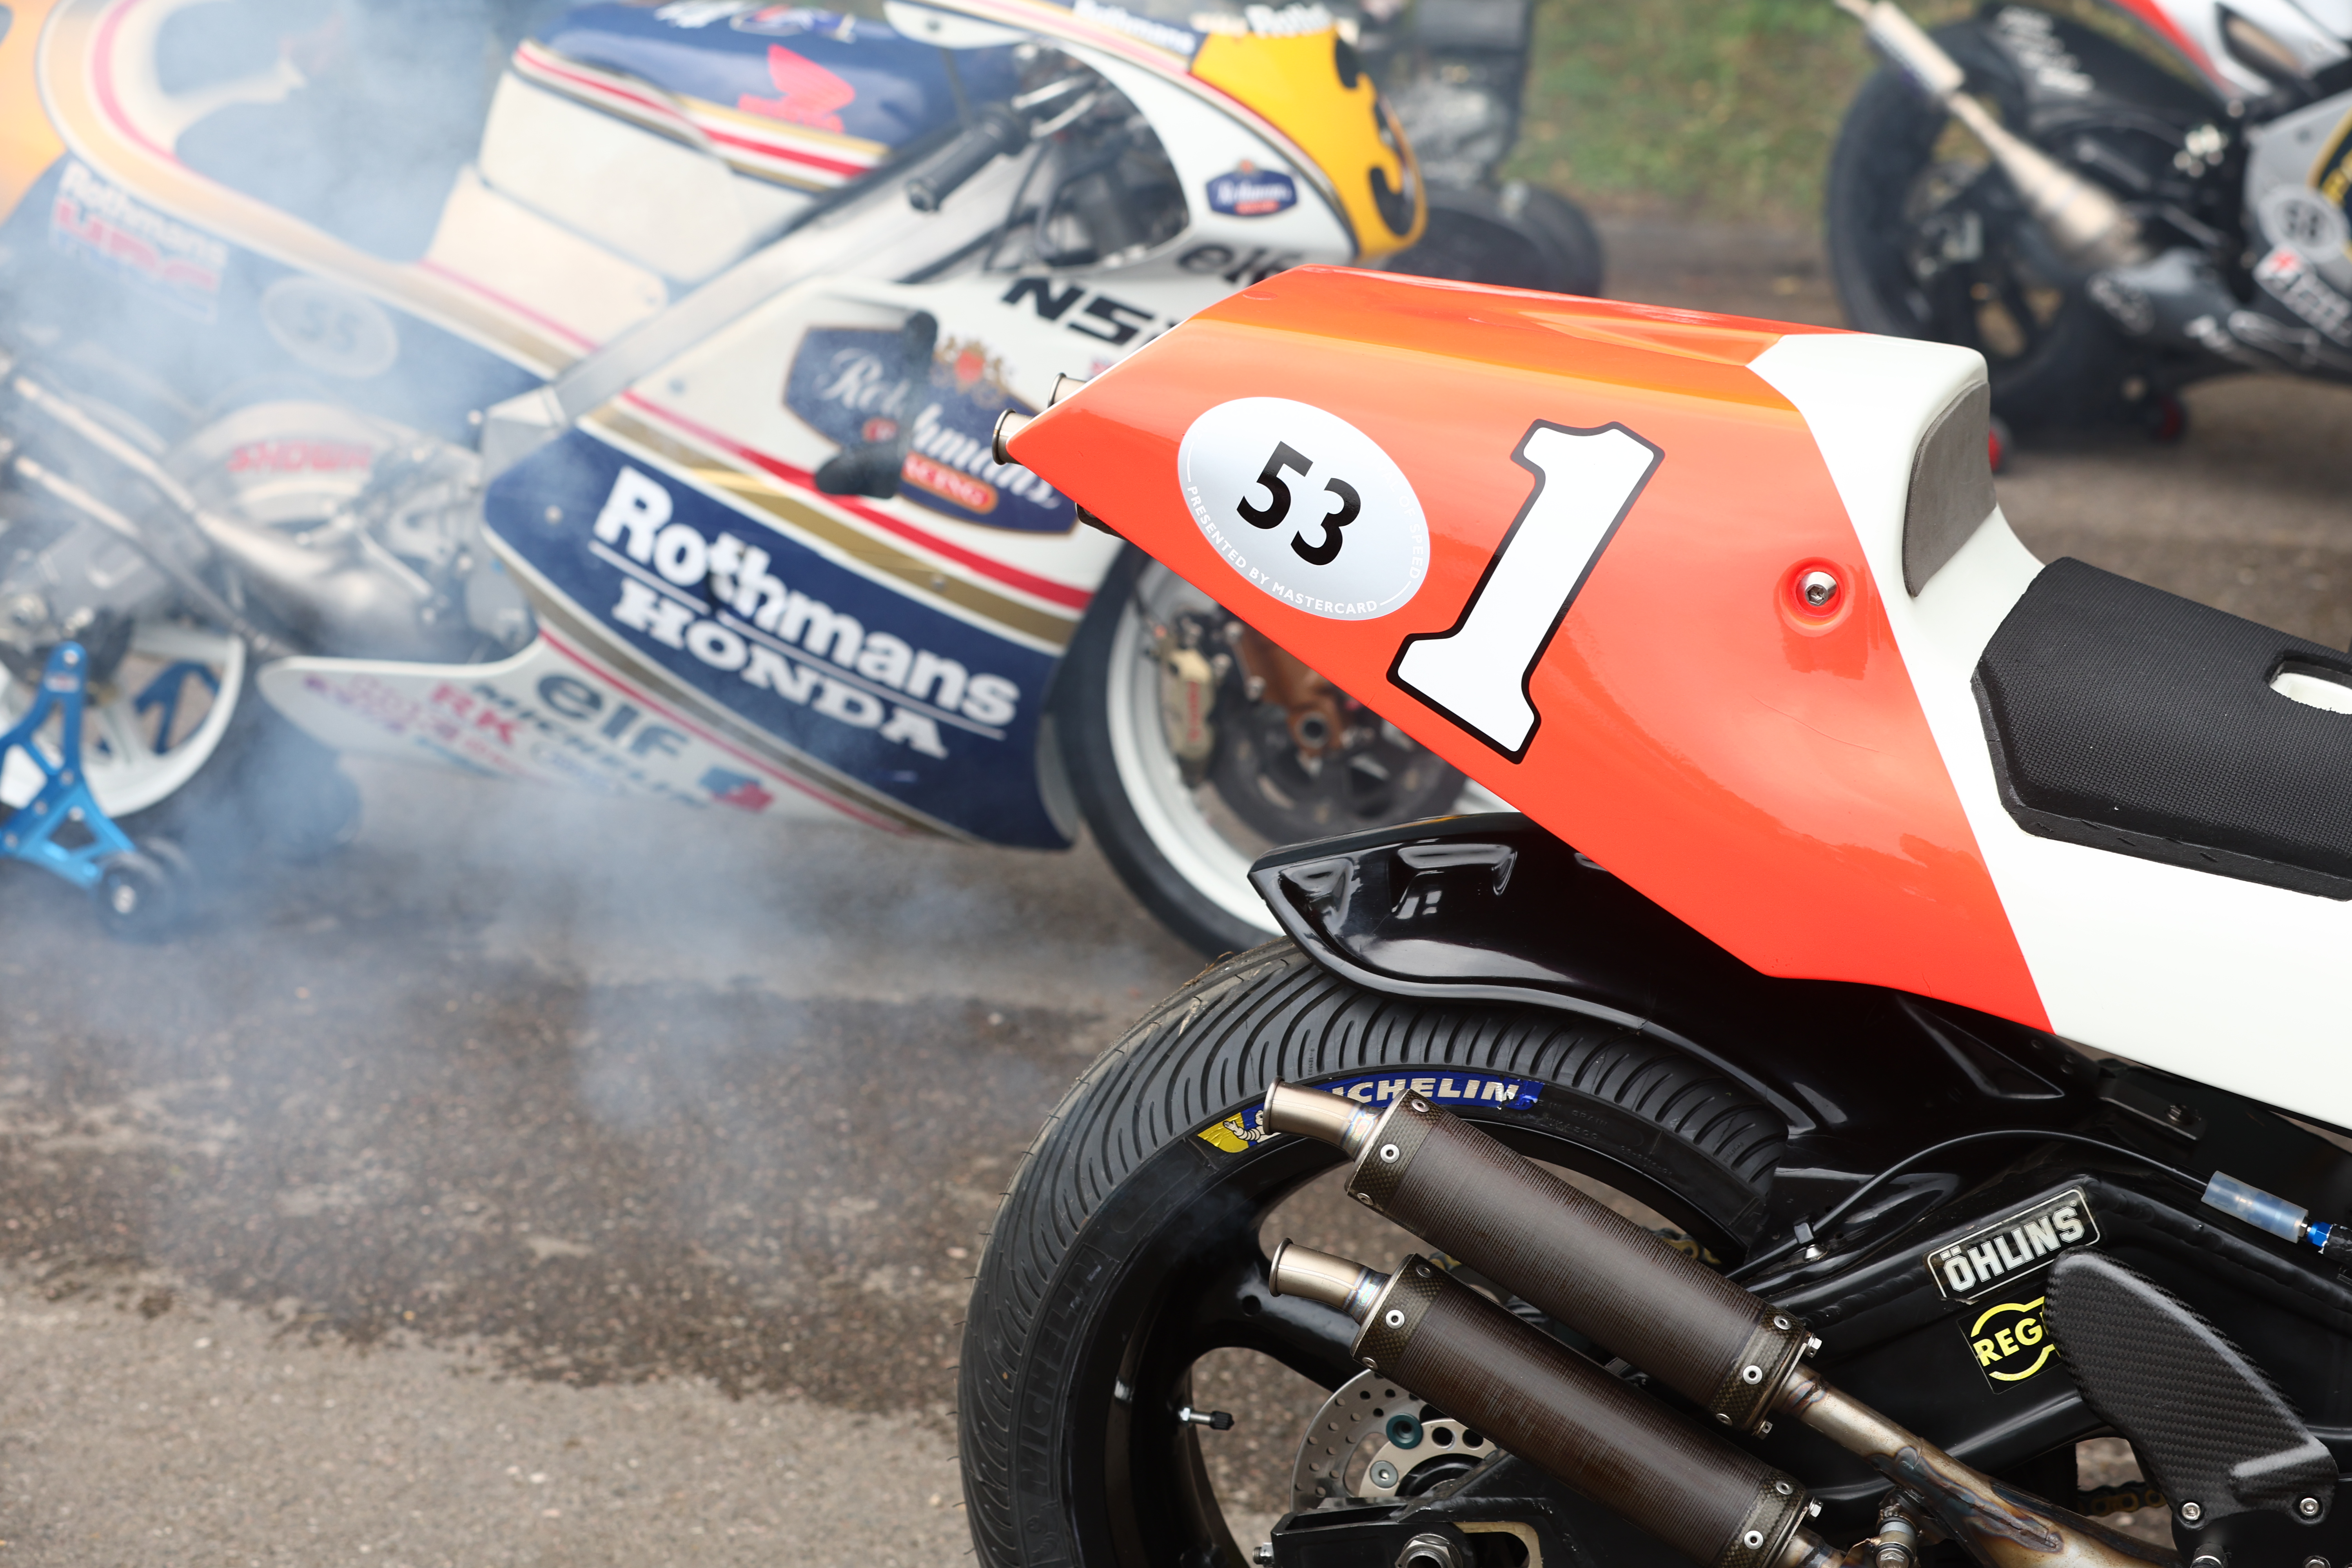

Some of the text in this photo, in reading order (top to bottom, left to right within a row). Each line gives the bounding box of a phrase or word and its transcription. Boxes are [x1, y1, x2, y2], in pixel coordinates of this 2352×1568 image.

[999, 277, 1186, 347] NS
[1187, 486, 1377, 614] PRESENTED BY MASTERCARD
[1236, 441, 1361, 566] 53
[1399, 495, 1416, 517] OF
[1409, 524, 1424, 579] SPEED
[593, 465, 1020, 726] Rothmans
[1387, 418, 1665, 764] 1
[536, 673, 691, 760] elf
[612, 577, 948, 760] HONDA
[1940, 1206, 2085, 1292] ÖHLINS
[1020, 1247, 1103, 1499] MICHELIN
[1973, 1312, 2049, 1367] REG
